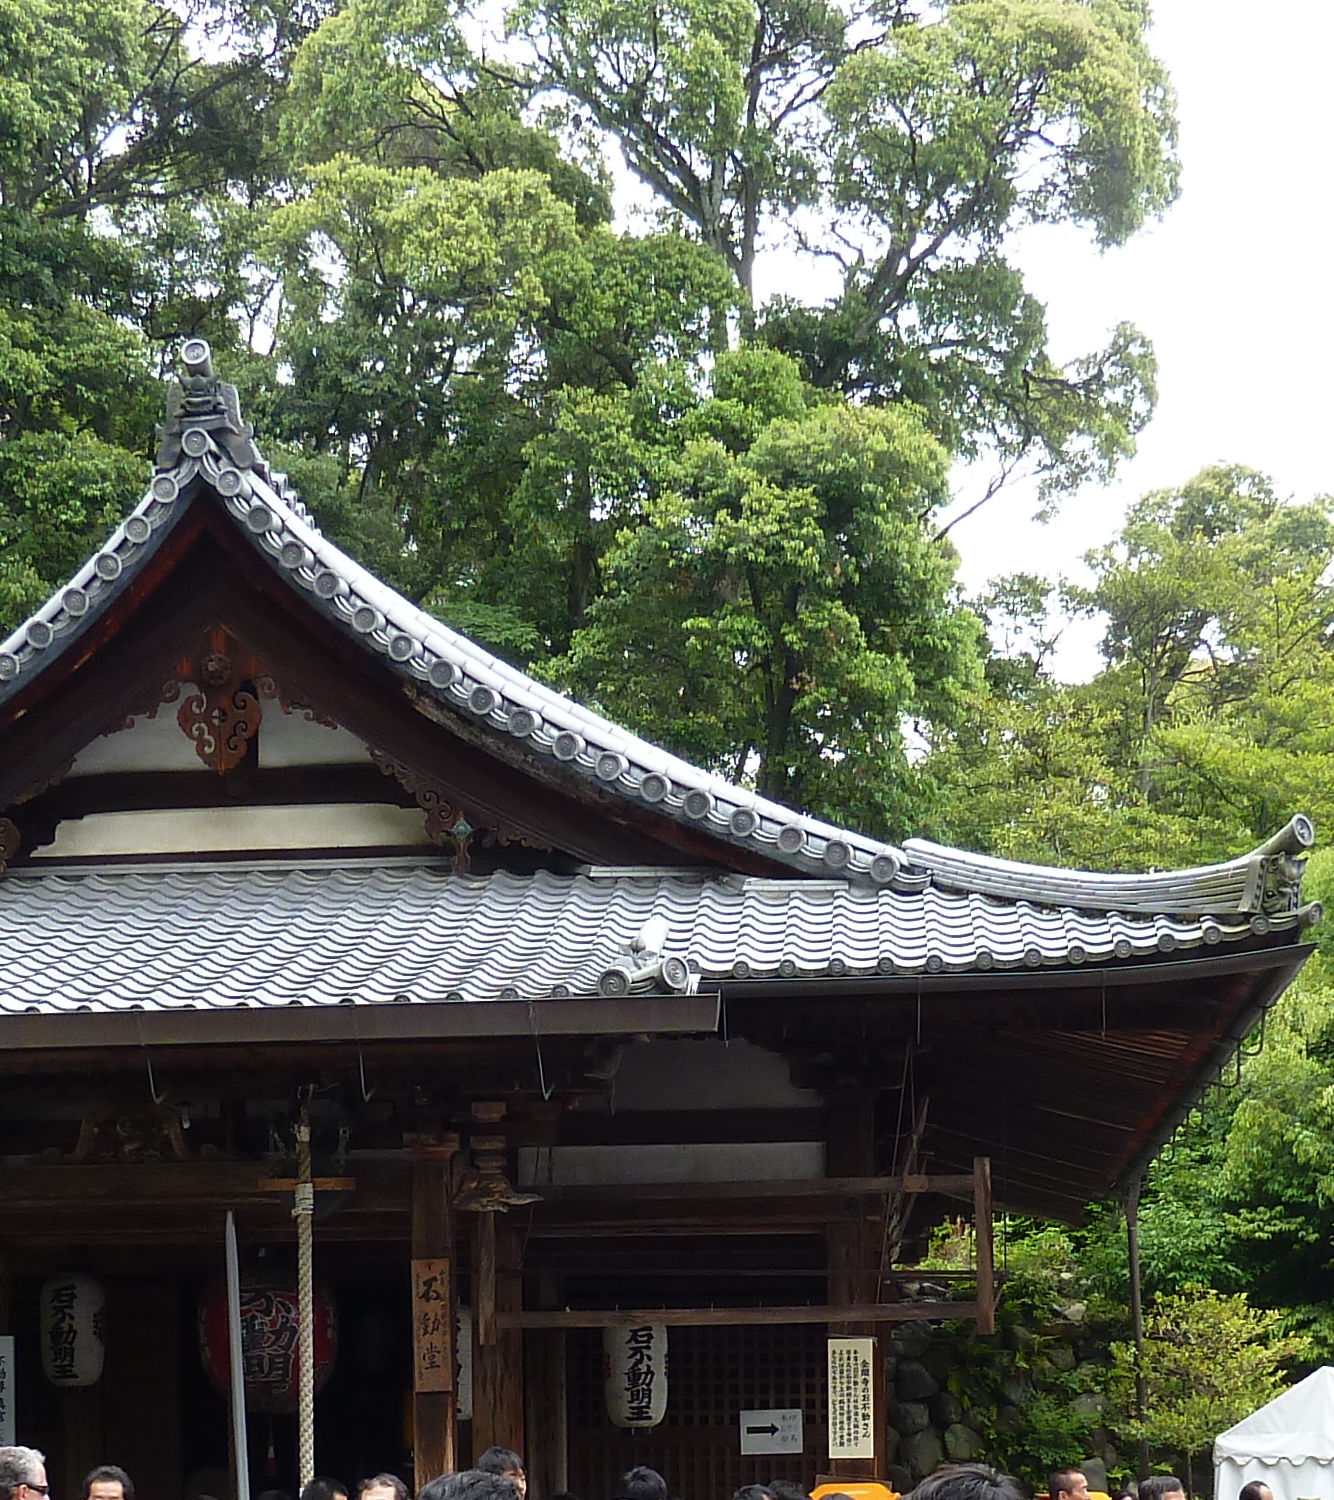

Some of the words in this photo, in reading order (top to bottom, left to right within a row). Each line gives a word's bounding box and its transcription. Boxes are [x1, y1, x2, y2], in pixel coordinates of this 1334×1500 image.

[47, 1283, 79, 1380] 石不動明王
[623, 1325, 656, 1422] 石不動明王
